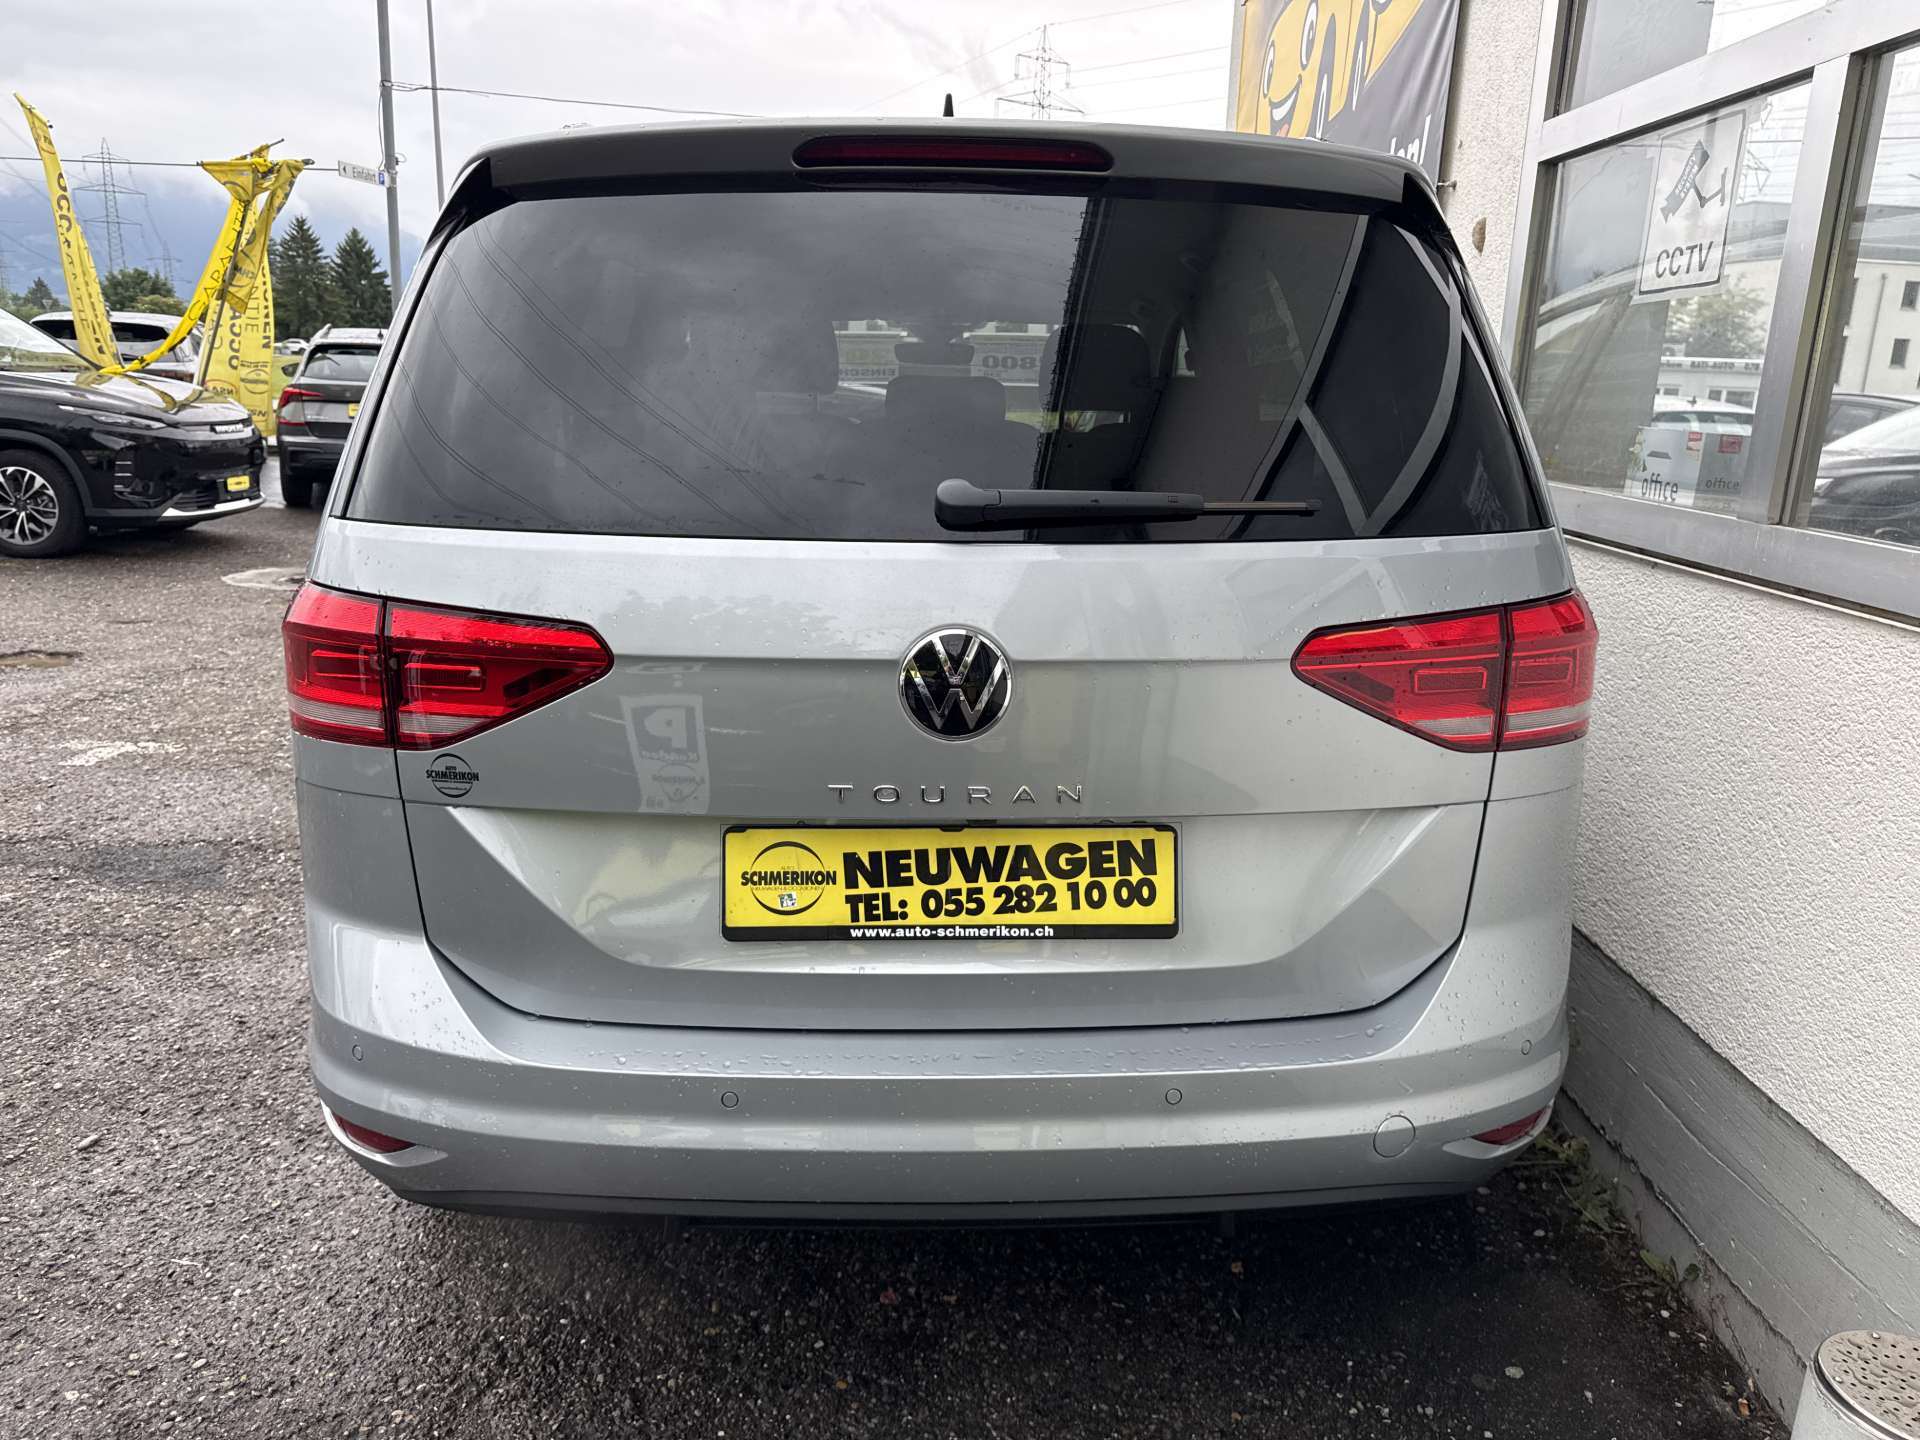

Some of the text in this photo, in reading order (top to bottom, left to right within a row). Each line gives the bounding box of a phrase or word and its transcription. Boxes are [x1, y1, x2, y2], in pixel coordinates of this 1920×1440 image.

[1655, 241, 1714, 279] CCTV
[1641, 472, 1679, 501] office
[1705, 477, 1740, 490] office
[426, 769, 479, 782] SCHMERIKON
[827, 784, 1082, 804] TOURAN
[843, 838, 1158, 890] NEUWAGEN
[741, 870, 836, 886] SCHMERIKON
[845, 877, 1157, 923] TEL: 055 282 10 00
[849, 925, 1054, 937] www.auto-schmerikon.ch
